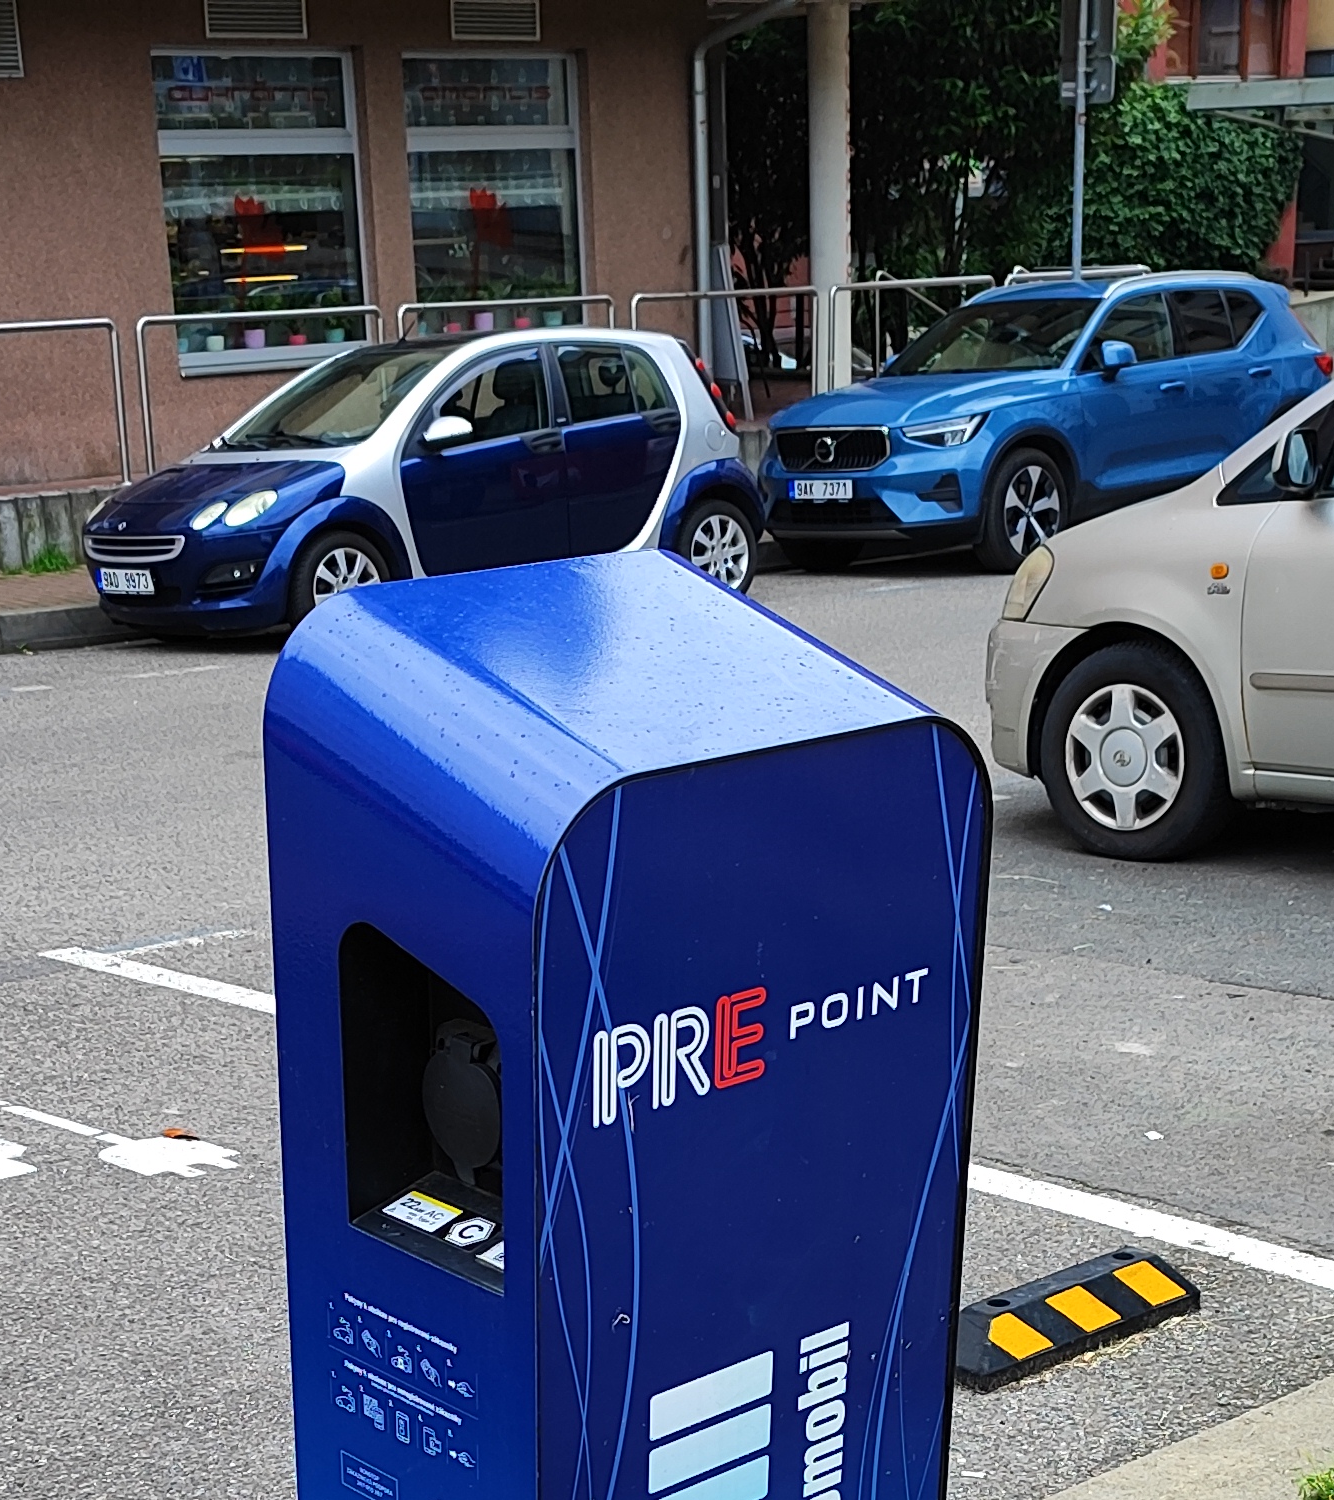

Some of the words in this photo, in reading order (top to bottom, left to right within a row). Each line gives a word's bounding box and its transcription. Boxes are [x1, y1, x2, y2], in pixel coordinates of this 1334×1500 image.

[796, 482, 814, 497] 9AK
[823, 482, 847, 497] 7371
[592, 986, 767, 1129] PRE
[789, 967, 929, 1040] POINT
[458, 1224, 485, 1240] C
